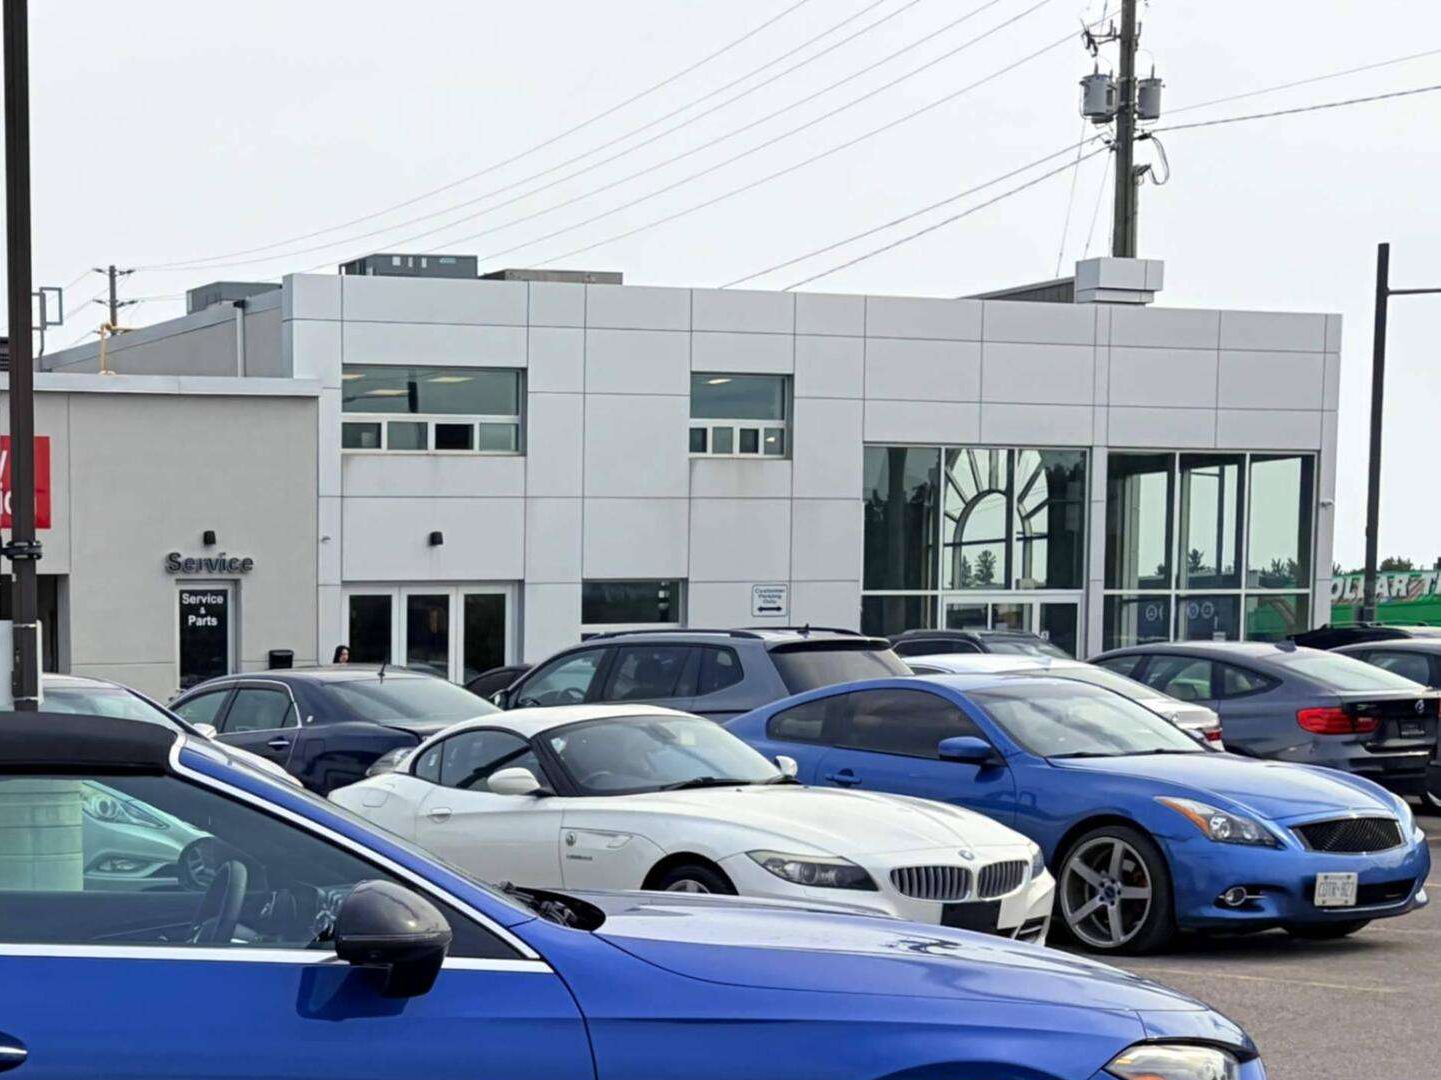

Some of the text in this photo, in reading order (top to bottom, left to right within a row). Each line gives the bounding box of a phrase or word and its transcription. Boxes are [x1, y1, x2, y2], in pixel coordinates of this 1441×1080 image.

[165, 552, 254, 574] Service
[181, 592, 224, 605] Service
[187, 614, 218, 626] Parts
